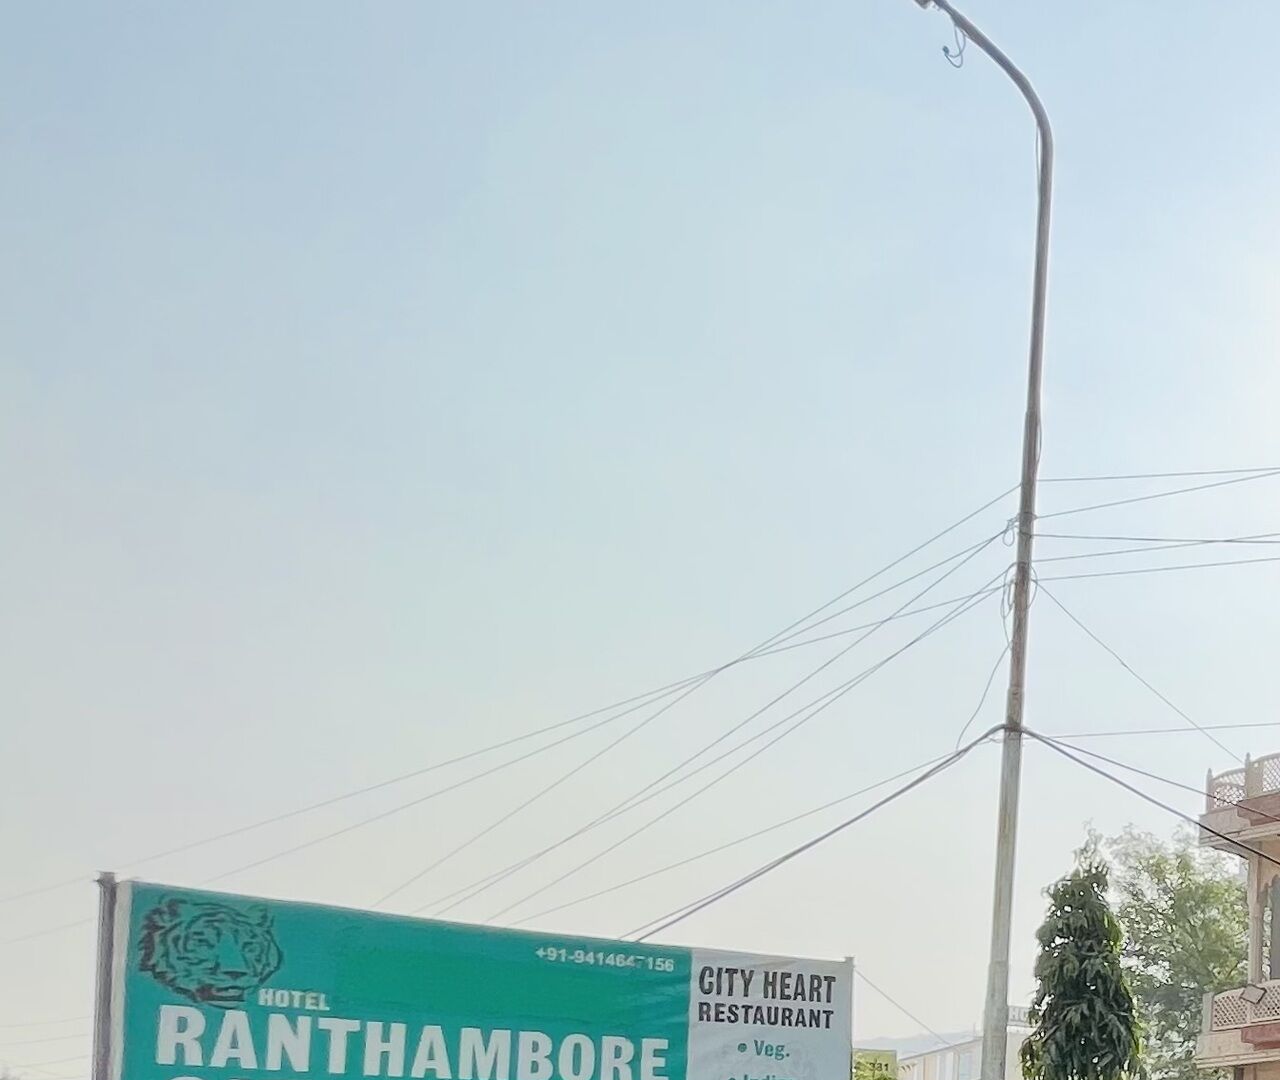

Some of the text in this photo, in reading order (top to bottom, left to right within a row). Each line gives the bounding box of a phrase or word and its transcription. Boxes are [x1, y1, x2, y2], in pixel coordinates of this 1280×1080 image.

[699, 965, 837, 1004] CITY HEART
[258, 988, 330, 1011] HOTEL
[698, 1002, 834, 1029] RESTAURANT
[754, 1040, 790, 1060] Veg.
